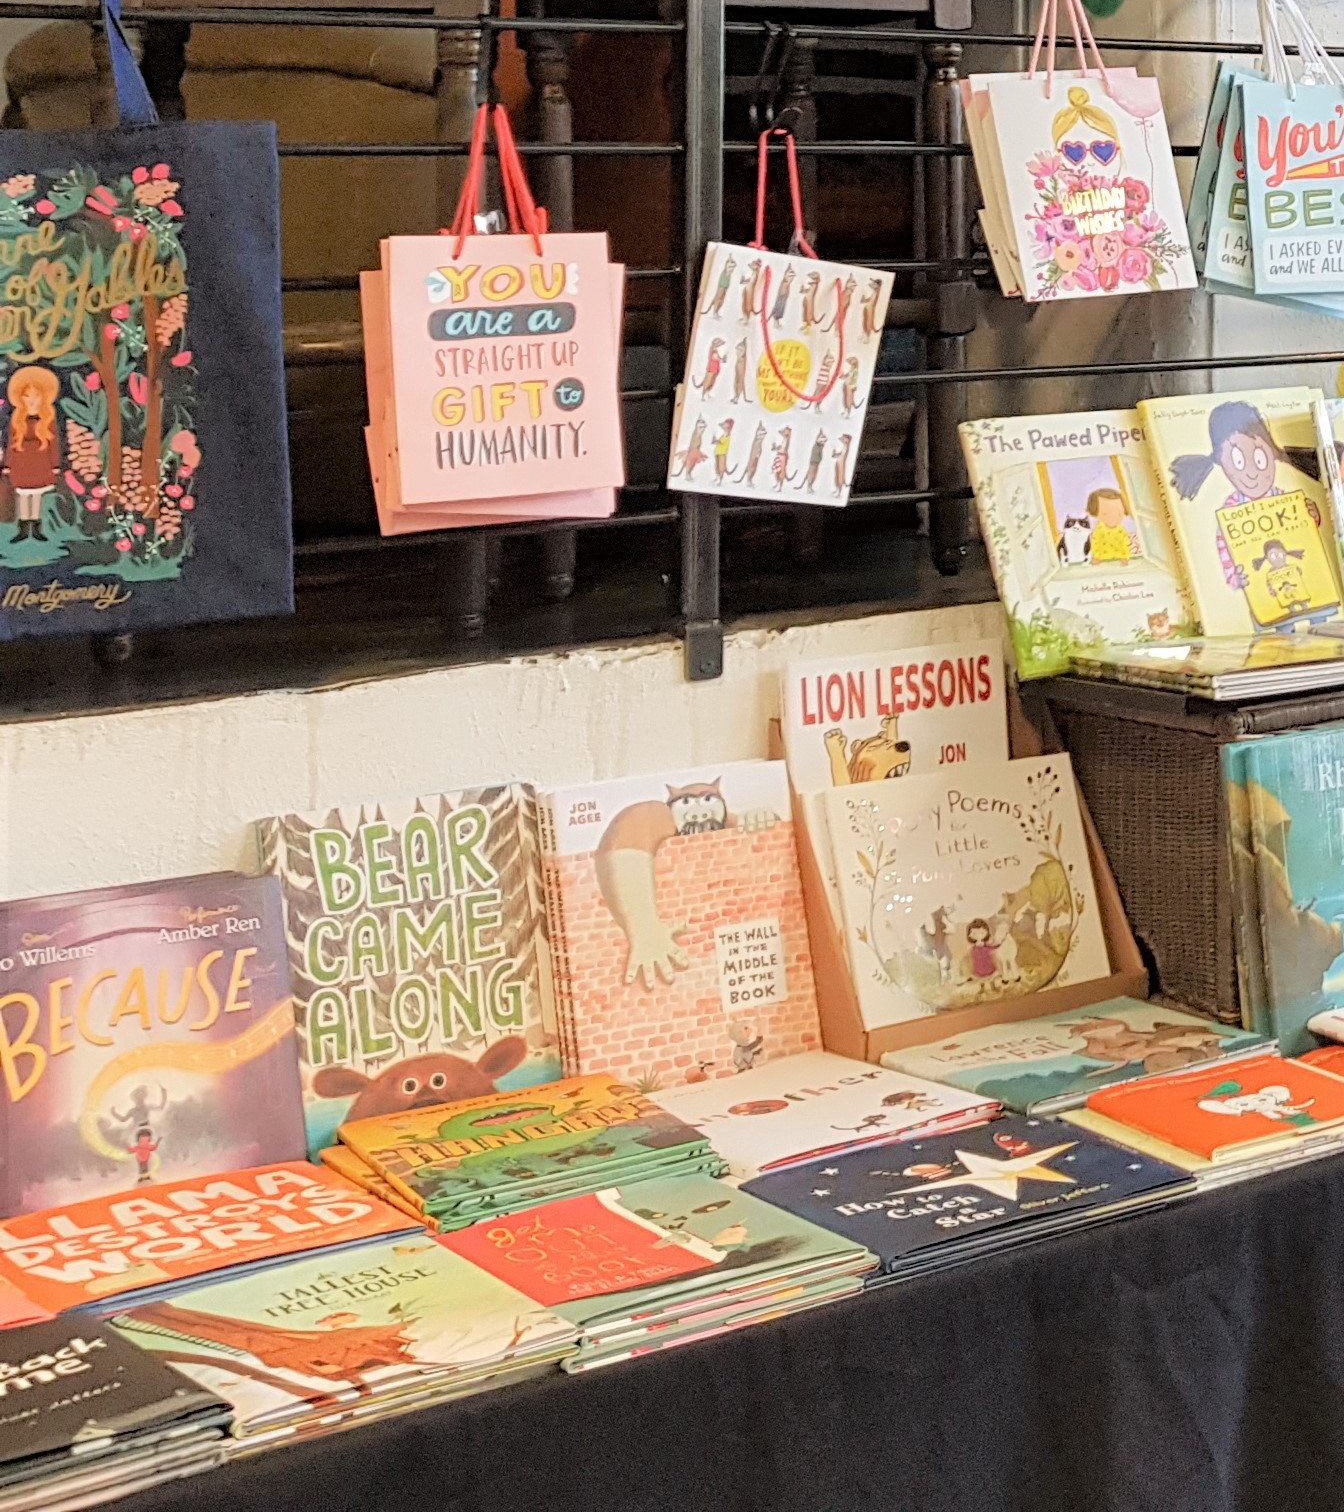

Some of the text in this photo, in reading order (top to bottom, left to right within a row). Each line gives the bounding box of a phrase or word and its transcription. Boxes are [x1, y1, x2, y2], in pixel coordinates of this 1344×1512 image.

[1222, 253, 1246, 267] and
[1279, 242, 1321, 258] ASKED
[1270, 259, 1293, 275] and
[1297, 259, 1317, 274] WE
[1321, 257, 1344, 273] ALL
[439, 262, 567, 300] YOU
[445, 307, 563, 336] are a
[435, 341, 581, 379] STRAIGHT UP
[433, 379, 584, 427] GIFT to
[435, 422, 589, 471] HUMANITY.
[984, 424, 1092, 454] The Pawed
[1222, 500, 1257, 522] LOOK!
[1226, 504, 1299, 540] BOOK!
[3, 580, 133, 614] Montgomery
[801, 654, 992, 727] LION LESSONS
[938, 742, 967, 766] JON
[569, 800, 597, 814] JON
[569, 811, 602, 827] AGEE
[948, 789, 1022, 820] Poems
[309, 803, 499, 913] BEAR
[935, 833, 989, 857] Little
[960, 854, 1021, 874] Lovers
[19, 915, 262, 966] Willems Amber Ren
[303, 890, 503, 985] CAME
[719, 926, 778, 945] THE WALL
[728, 943, 767, 957] IN THE
[724, 954, 778, 973] MIDDLE
[728, 971, 775, 987] OF THE
[729, 985, 777, 1006] BOOK
[0, 946, 259, 1103] BECAUSE
[305, 958, 525, 1068] ALONG
[930, 1034, 1049, 1063] Lawrence
[1007, 1040, 1071, 1060] Fall
[0, 1170, 320, 1251] LLAMA
[834, 1191, 944, 1217] How to
[886, 1194, 982, 1220] Catch
[935, 1206, 1007, 1228] Star
[958, 1205, 978, 1216] a
[5, 1185, 351, 1269] DESTROYS
[24, 1201, 374, 1284] WORLD
[264, 1266, 440, 1320] TREE HOUSE
[277, 1264, 395, 1304] TALLEST
